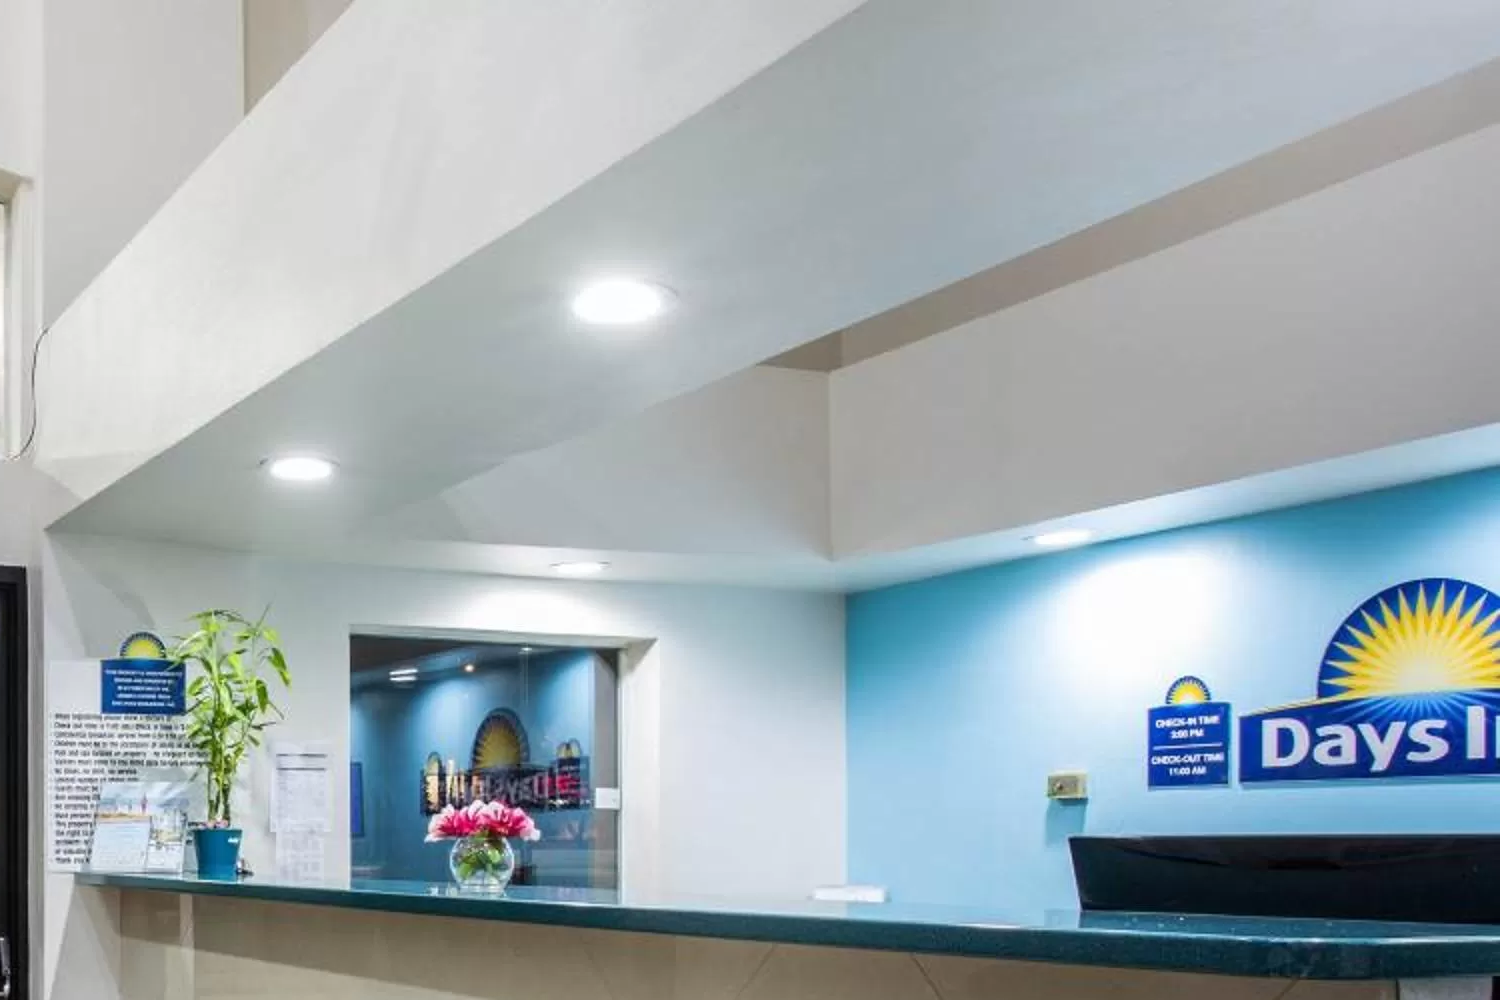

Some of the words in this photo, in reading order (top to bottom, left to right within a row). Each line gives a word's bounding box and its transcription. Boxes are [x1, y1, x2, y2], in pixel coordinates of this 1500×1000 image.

[1155, 716, 1197, 728] CHECK-IN
[1198, 715, 1221, 725] TIME
[1190, 728, 1205, 738] PM
[1261, 717, 1449, 773] Days
[1466, 705, 1500, 759] I
[1151, 754, 1203, 765] CHECK-OUT
[1203, 753, 1225, 763] TIME
[1169, 767, 1190, 776] 11:00
[1192, 766, 1207, 775] AM
